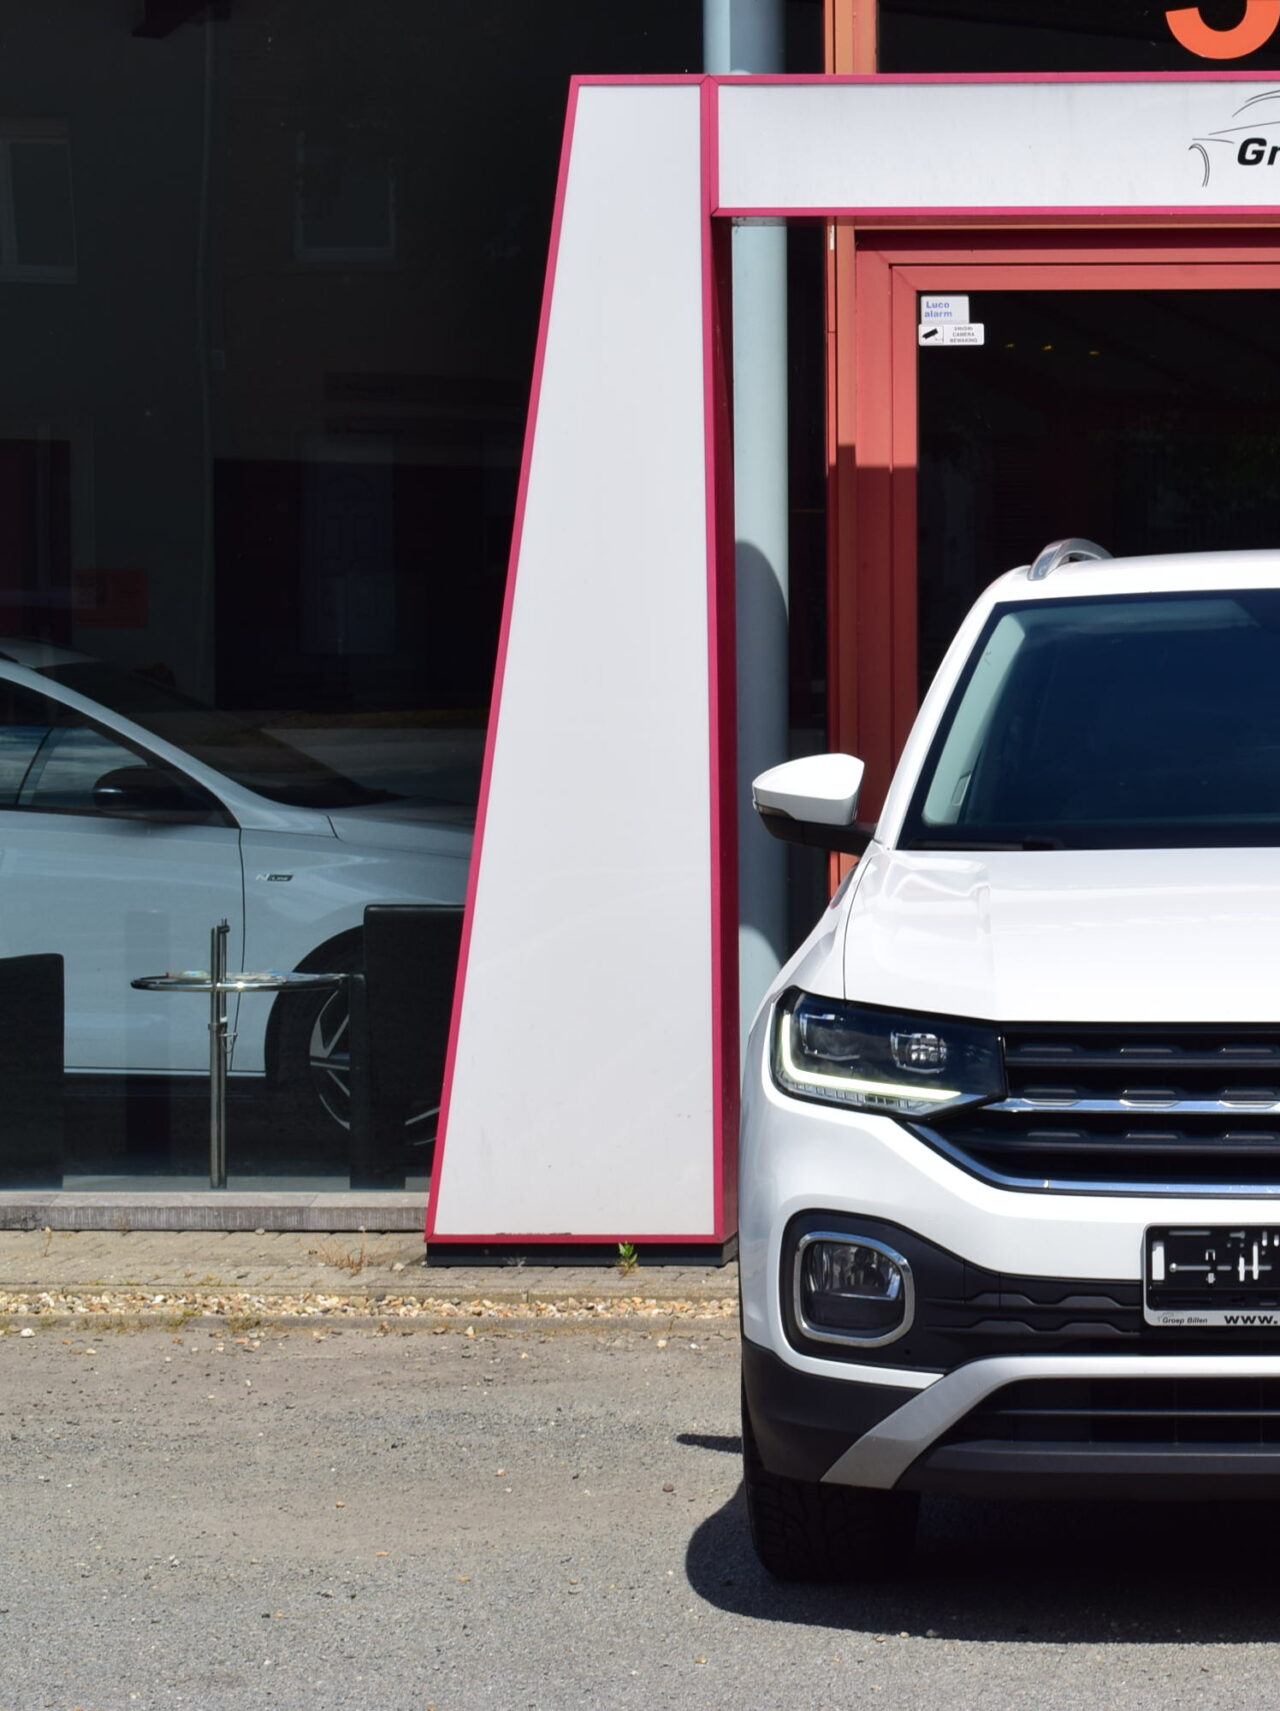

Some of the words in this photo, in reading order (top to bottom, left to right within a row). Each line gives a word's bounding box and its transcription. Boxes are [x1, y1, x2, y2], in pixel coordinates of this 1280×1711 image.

[926, 301, 950, 309] Luco
[924, 310, 953, 318] alarm
[1162, 1316, 1184, 1326] Groep
[1187, 1316, 1208, 1324] Billen
